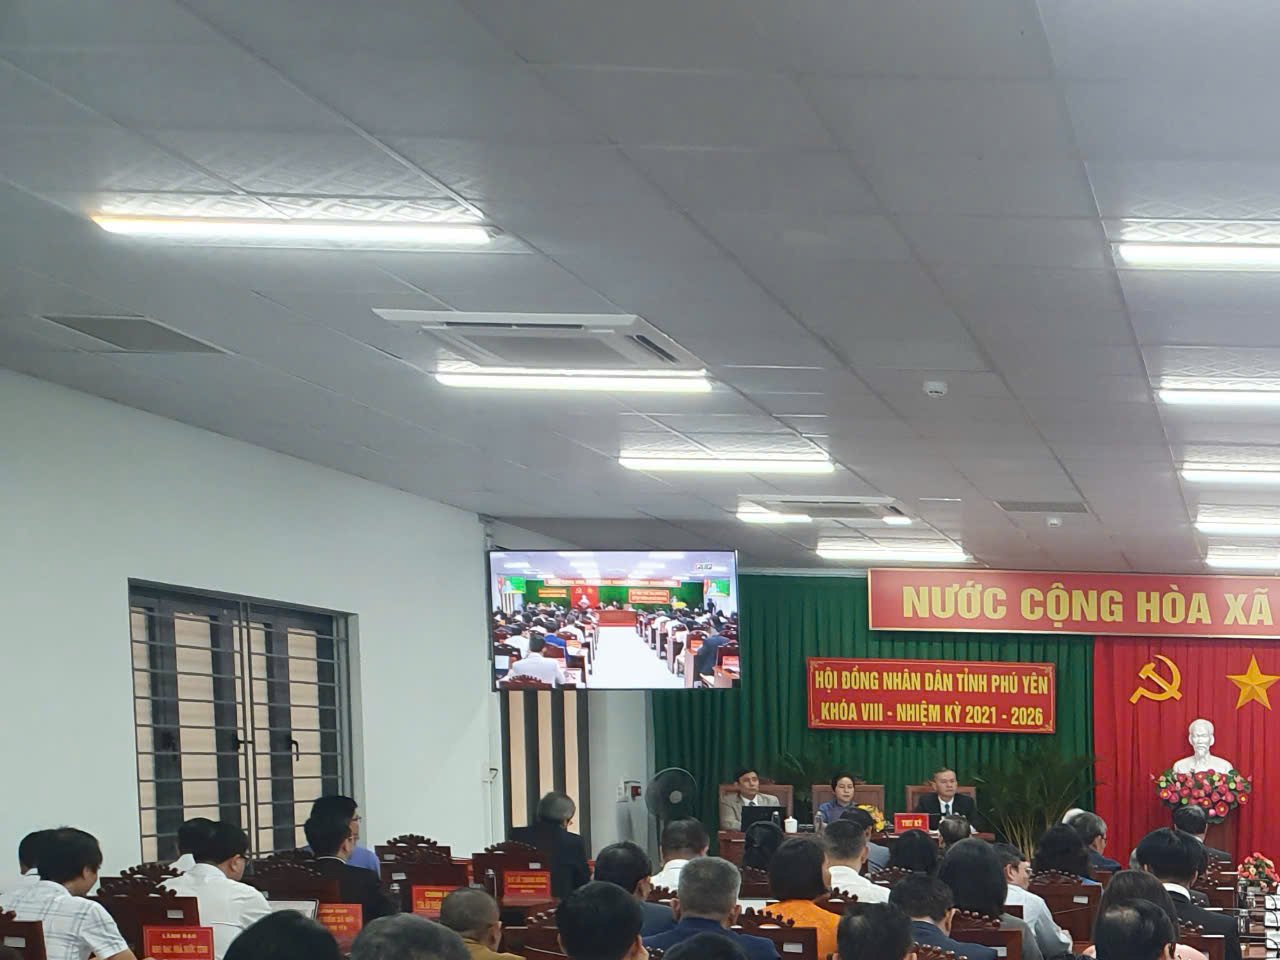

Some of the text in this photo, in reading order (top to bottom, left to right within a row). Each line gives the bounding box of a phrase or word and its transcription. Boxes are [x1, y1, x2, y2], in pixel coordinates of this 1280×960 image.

[902, 583, 1007, 620] NƯỚC
[1020, 581, 1124, 628] CỘNG
[1137, 584, 1212, 626] HÒA
[1223, 587, 1274, 627] XÃ
[815, 665, 1049, 694] HỘI ĐỒNG NHÂN DÂN TỈNH PHÚ YÊN
[821, 698, 858, 721] KHÓA
[860, 703, 883, 721] VIII
[896, 700, 941, 726] NHIỆM
[944, 701, 962, 723] KỲ
[965, 705, 996, 724] 2021
[1010, 707, 1044, 726] 2026
